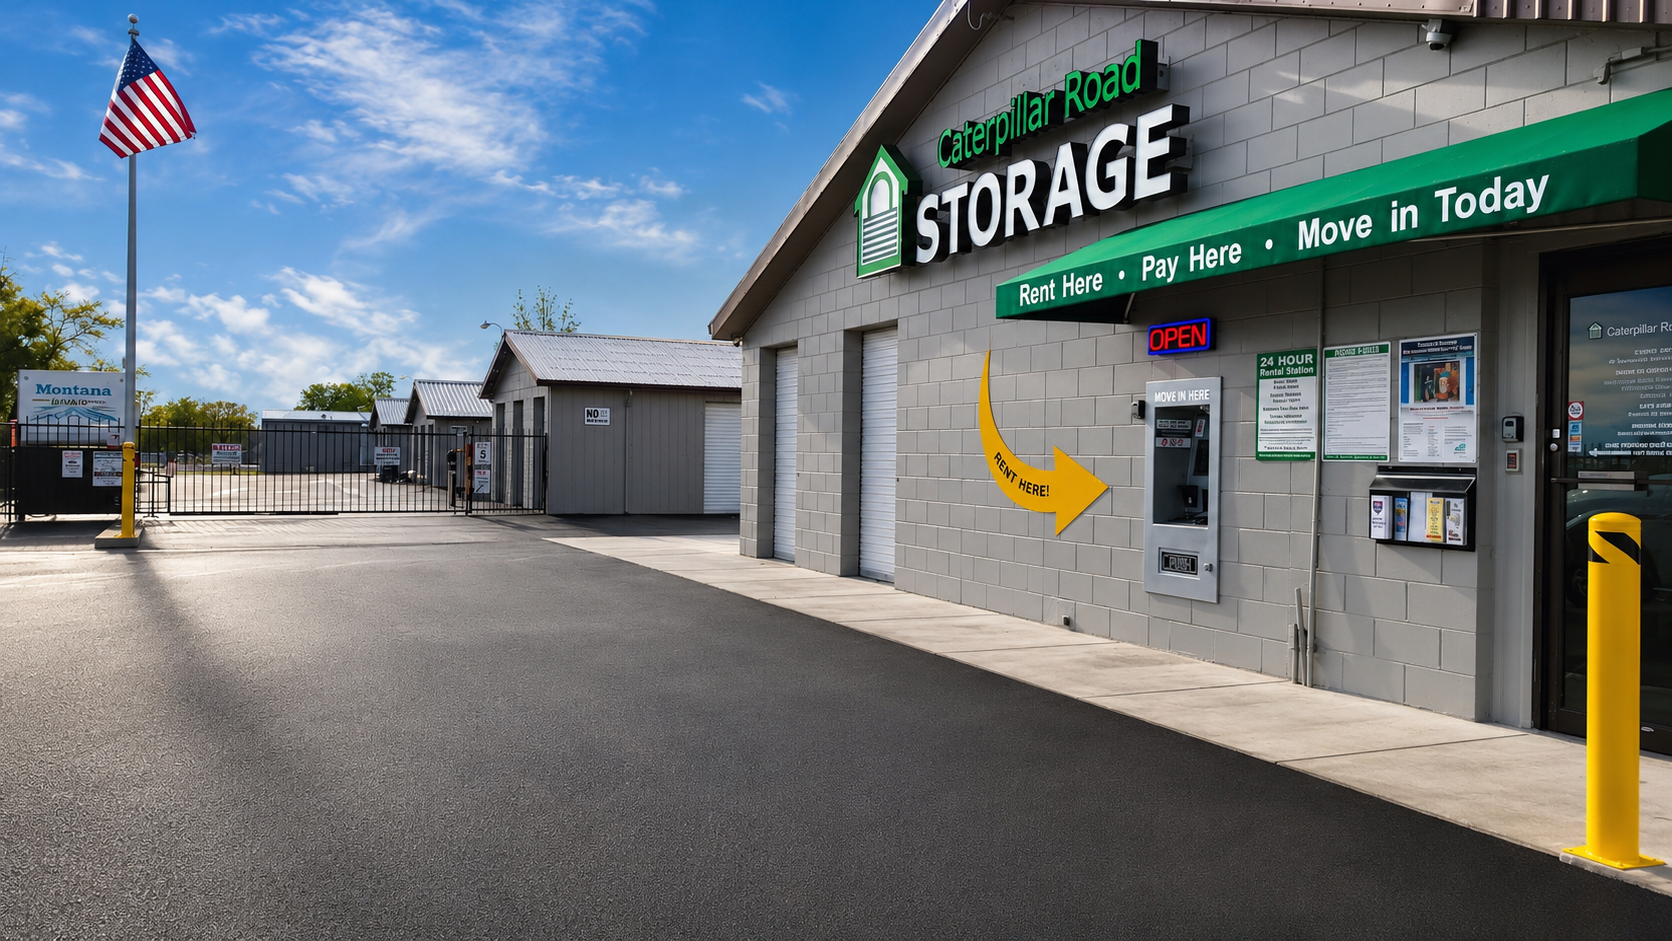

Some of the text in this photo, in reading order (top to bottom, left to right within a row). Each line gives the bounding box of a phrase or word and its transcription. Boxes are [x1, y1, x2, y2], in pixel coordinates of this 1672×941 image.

[938, 39, 1142, 168] Caterpillar Road
[916, 103, 1174, 264] STORAGE
[1019, 174, 1550, 306] Rent Here Pay Here Move in Today
[1149, 322, 1208, 351] OPEN
[1606, 323, 1658, 337] Caterpillar
[1260, 353, 1314, 368] 24 HOUR
[1260, 365, 1314, 377] Rental Station
[35, 383, 112, 396] Montana
[1154, 388, 1210, 403] MOVE IN HERE
[586, 408, 600, 419] NO
[994, 451, 1050, 498] RENT HERE!
